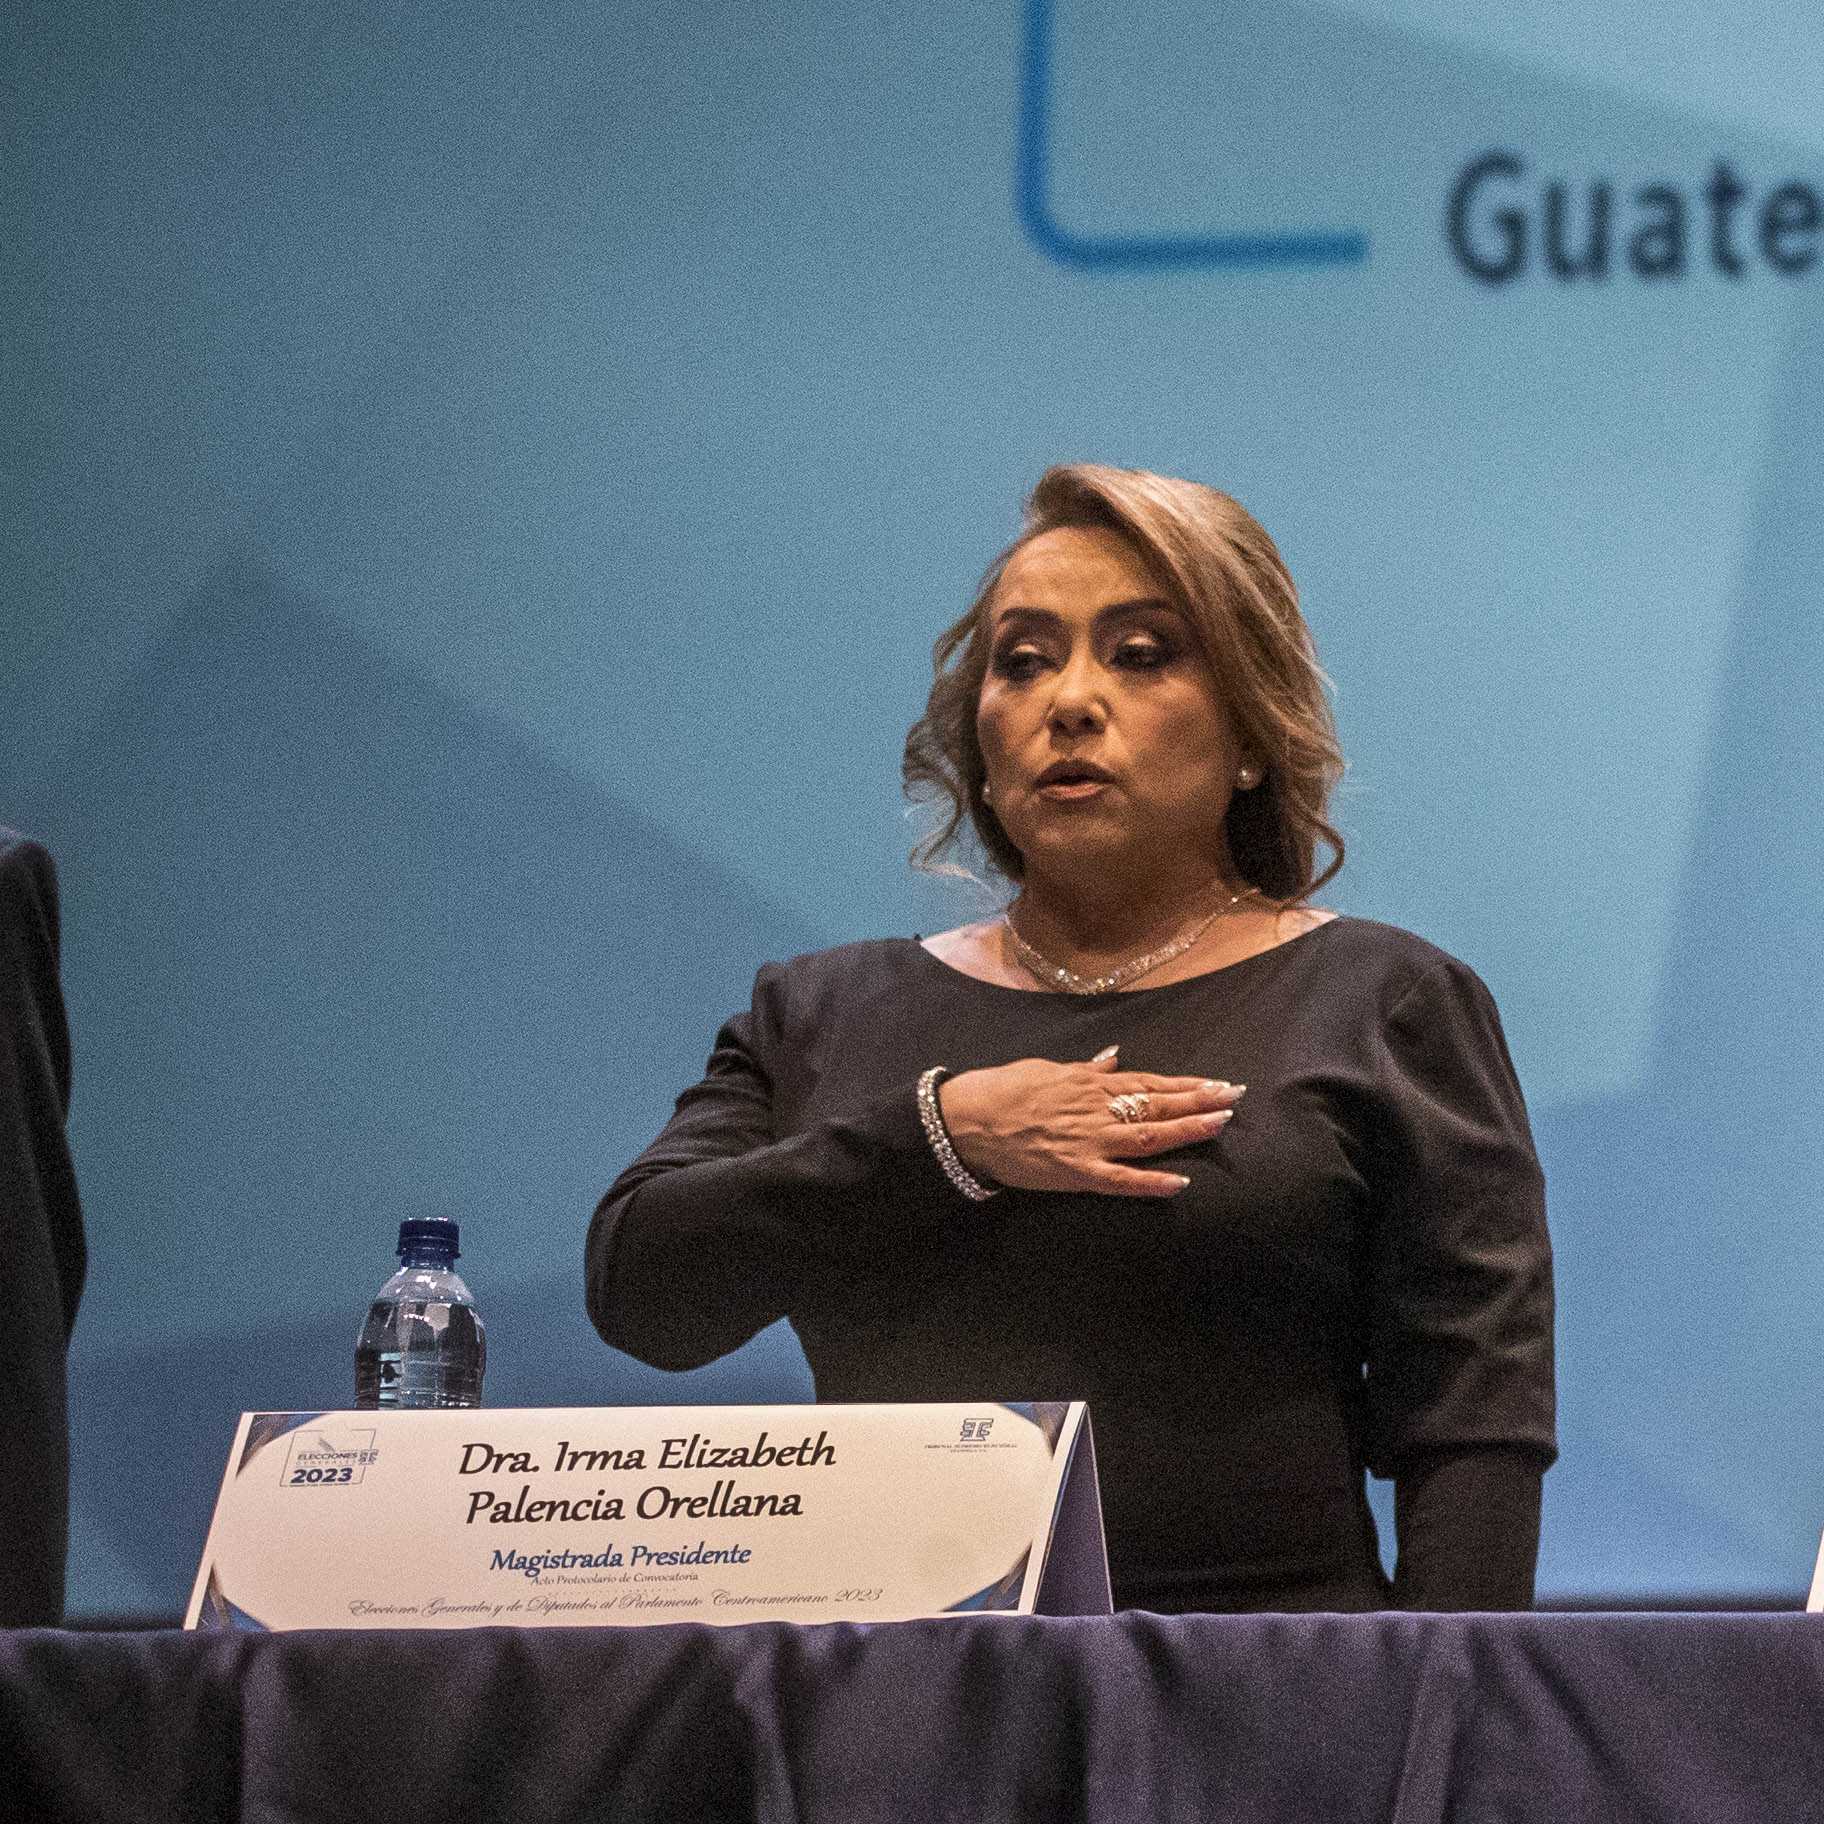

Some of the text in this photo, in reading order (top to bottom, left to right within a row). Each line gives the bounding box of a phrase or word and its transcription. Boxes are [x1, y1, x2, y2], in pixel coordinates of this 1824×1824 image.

[458, 1430, 837, 1475] Dra. Irma Elizabeth
[290, 1467, 353, 1484] 2023
[466, 1479, 804, 1524] Palencia Orellana
[489, 1540, 752, 1580] Magistrada Presidente
